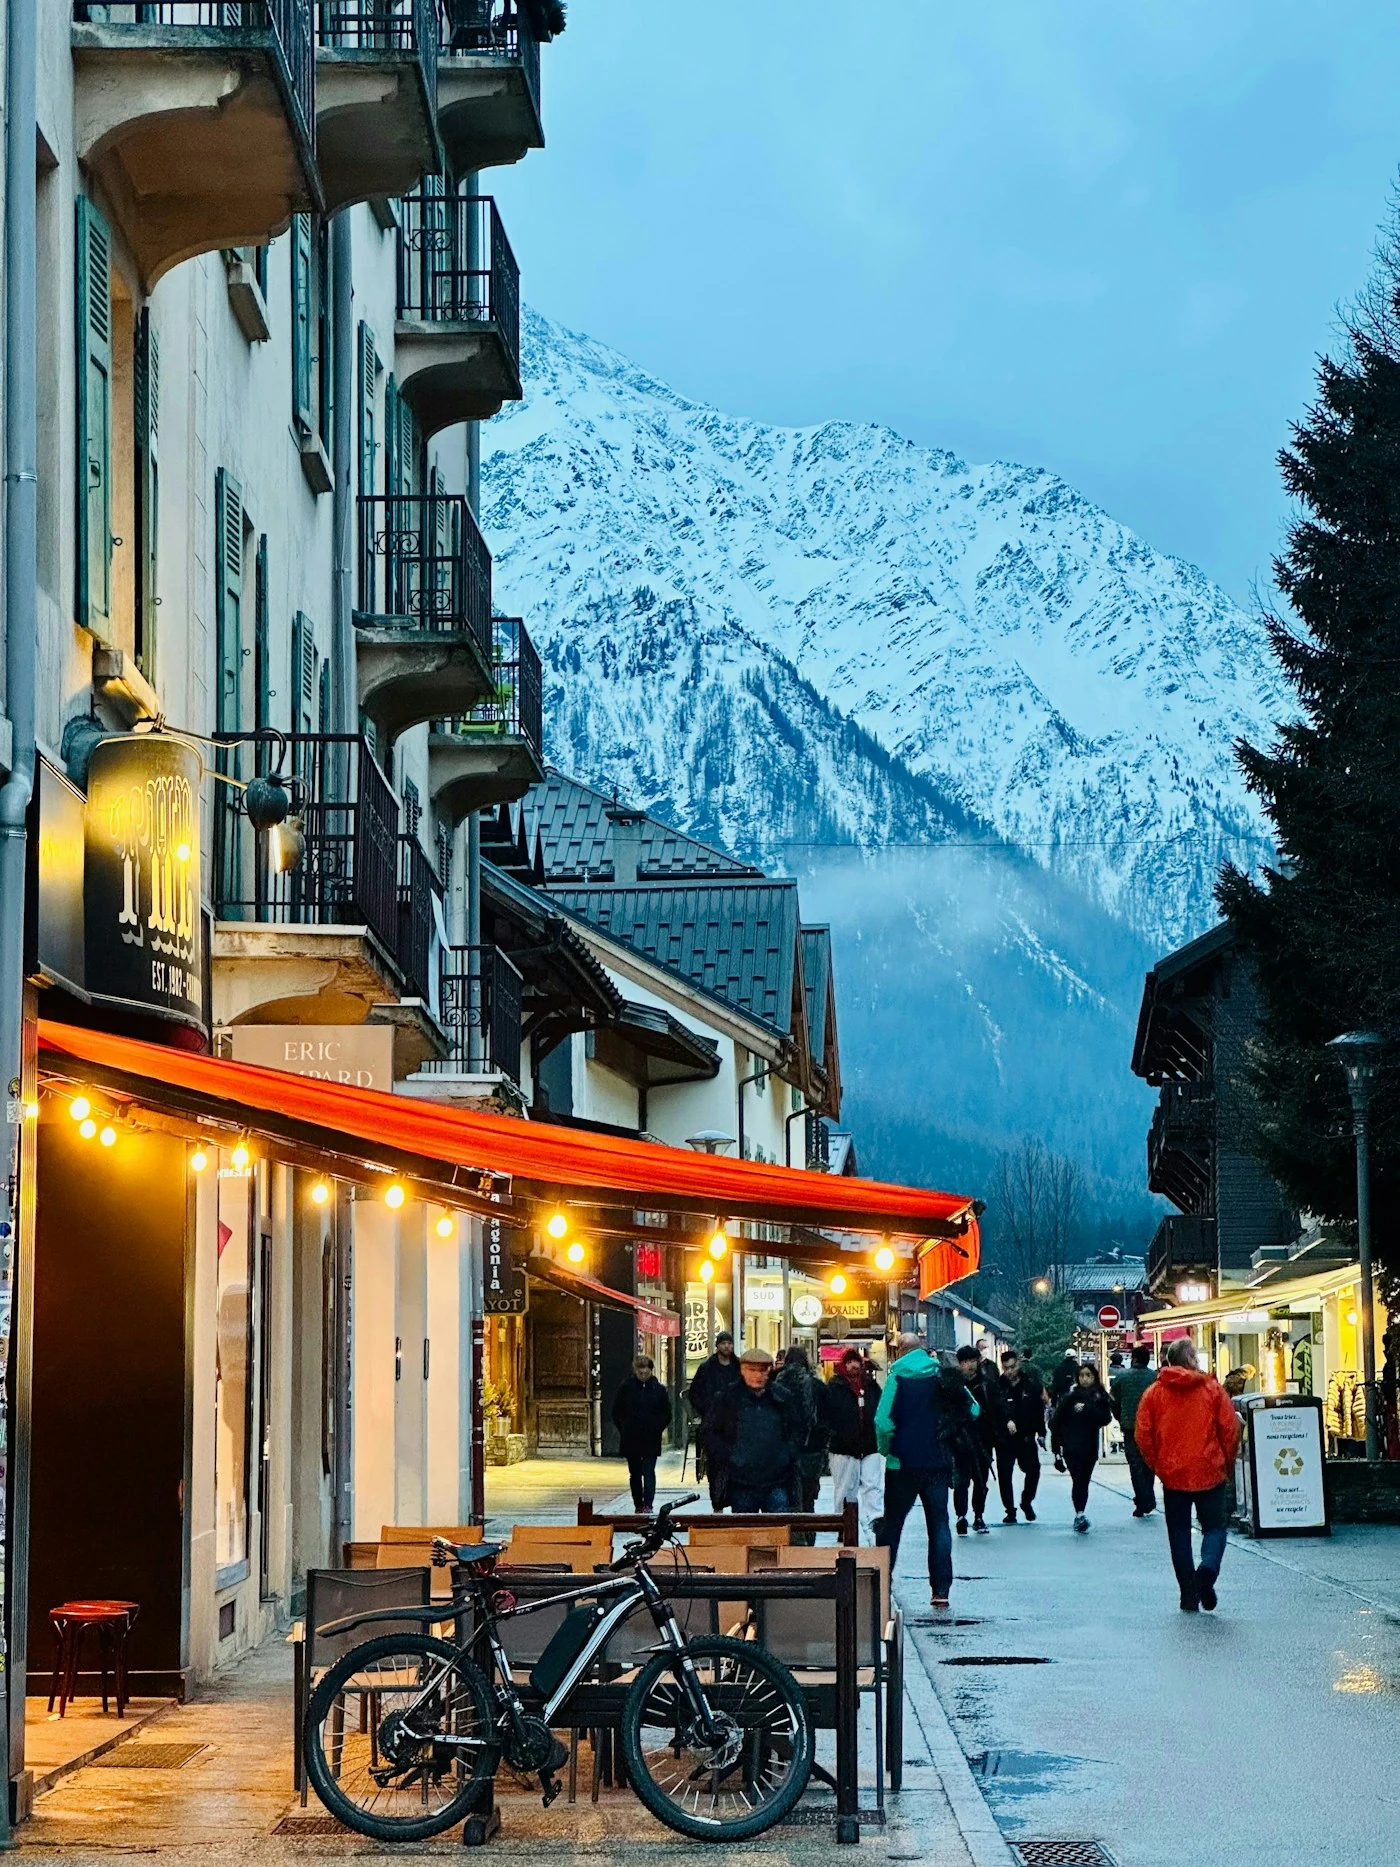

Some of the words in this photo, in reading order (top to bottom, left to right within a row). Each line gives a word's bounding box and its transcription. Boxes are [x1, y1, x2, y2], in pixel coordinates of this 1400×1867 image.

[151, 960, 168, 993] EST.
[284, 1041, 341, 1061] ERIC
[753, 1291, 775, 1300] SUD
